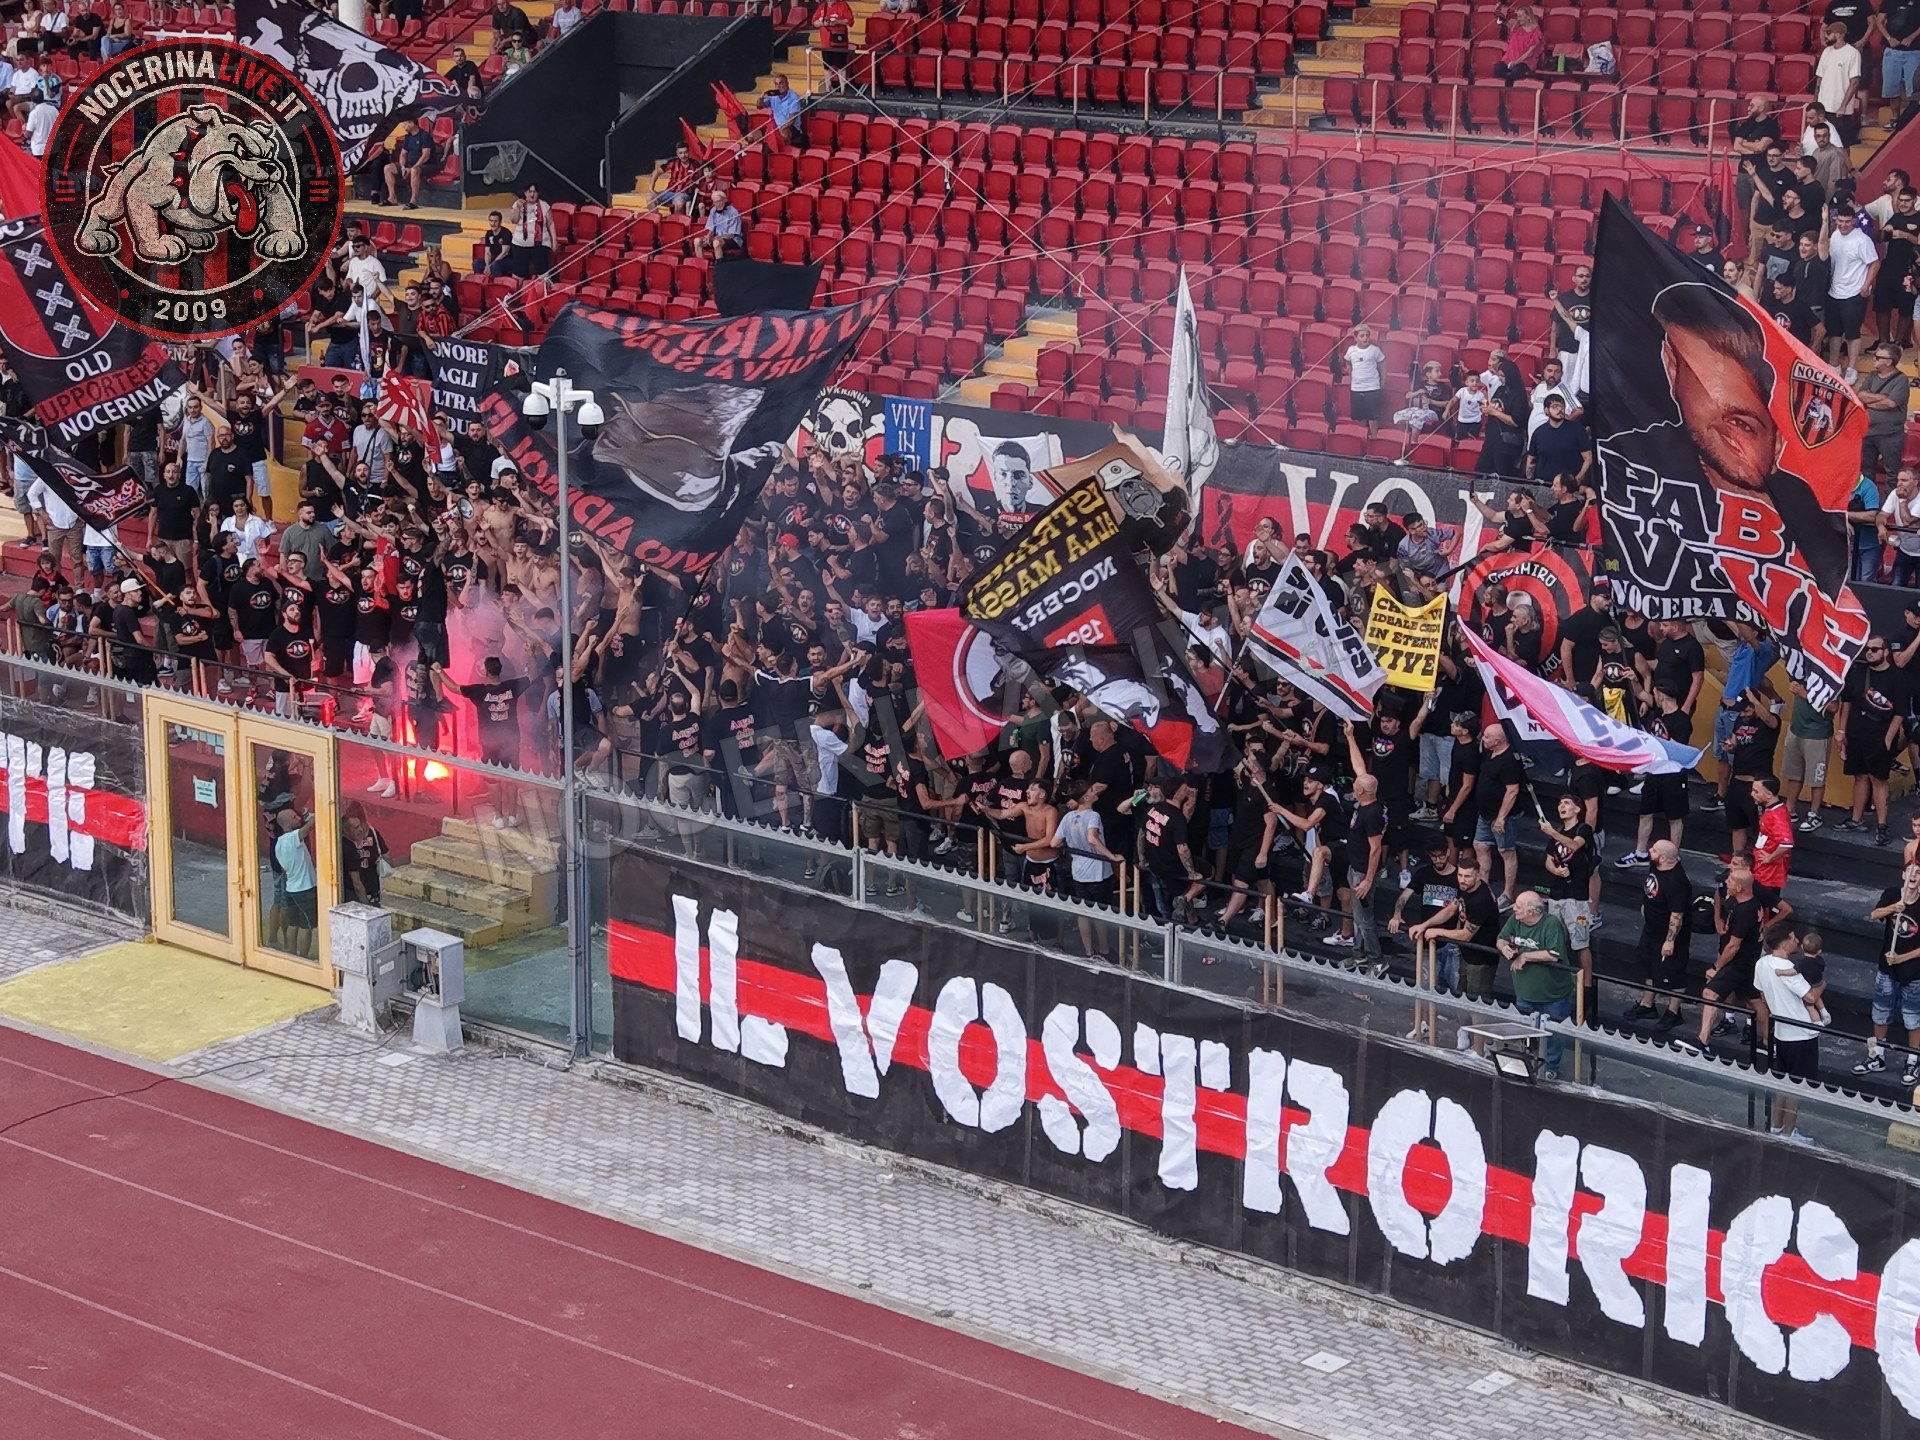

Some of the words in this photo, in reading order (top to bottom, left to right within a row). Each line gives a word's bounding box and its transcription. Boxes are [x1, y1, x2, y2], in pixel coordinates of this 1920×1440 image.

[65, 350, 112, 382] OLD
[438, 366, 479, 389] AGLI
[39, 354, 161, 422] UPPORTERS
[58, 377, 171, 441] NOCERINA
[891, 403, 926, 431] VIVI
[1596, 444, 1815, 580] FAB
[1608, 576, 1727, 622] NOCERA
[1368, 626, 1390, 641] IN
[1372, 612, 1419, 632] IDEALE
[1366, 641, 1436, 677] VIVE
[671, 894, 789, 1068] IL
[811, 940, 1487, 1266] VOSTRO
